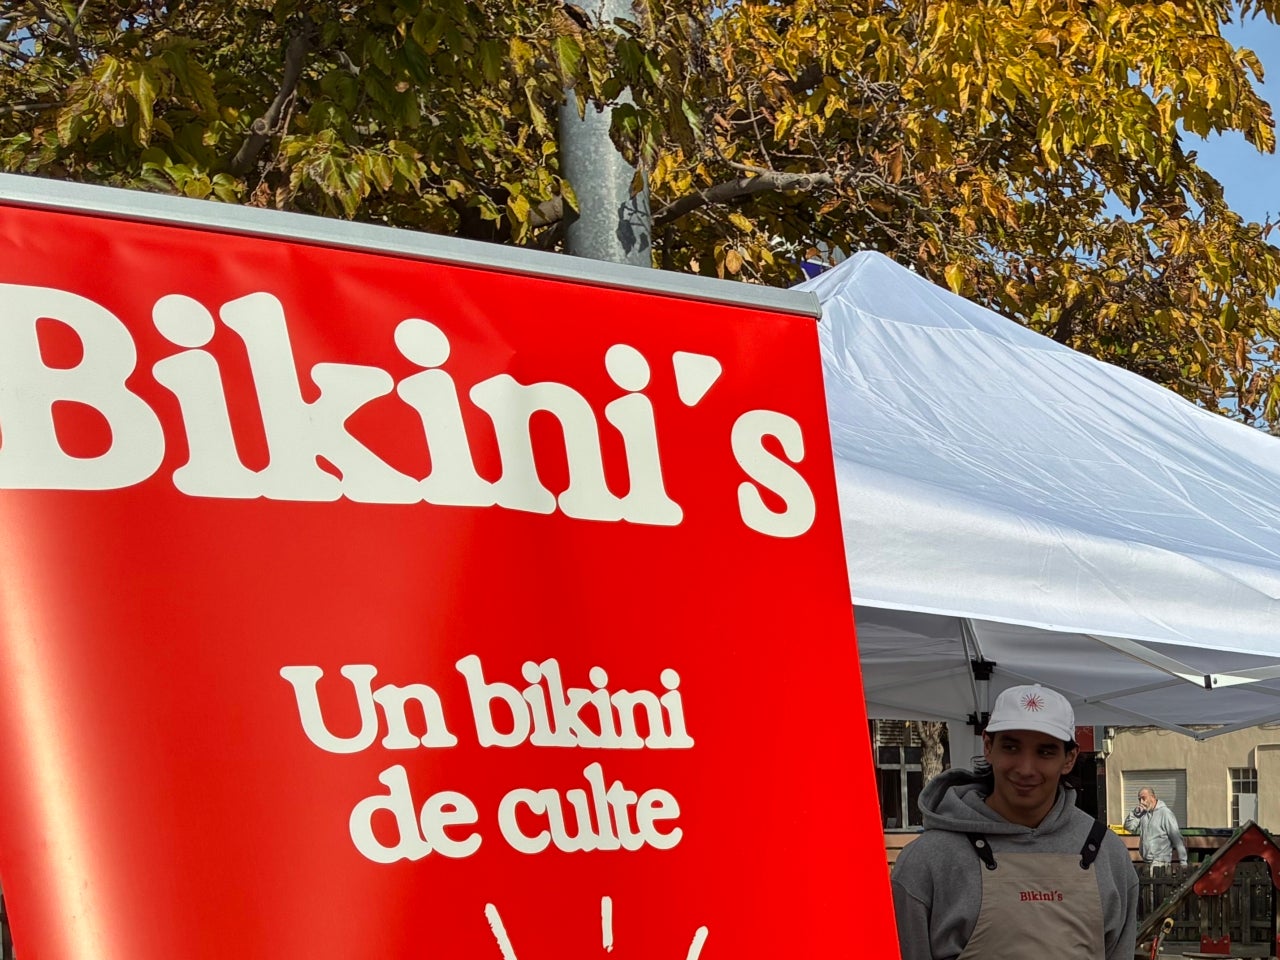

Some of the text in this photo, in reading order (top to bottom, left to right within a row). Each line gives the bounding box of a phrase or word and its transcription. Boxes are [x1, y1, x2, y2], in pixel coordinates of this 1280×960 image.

[0, 283, 817, 539] Bikini's
[280, 654, 696, 755] Un bikini
[349, 761, 684, 864] de culte
[1020, 890, 1063, 902] Bikini's
